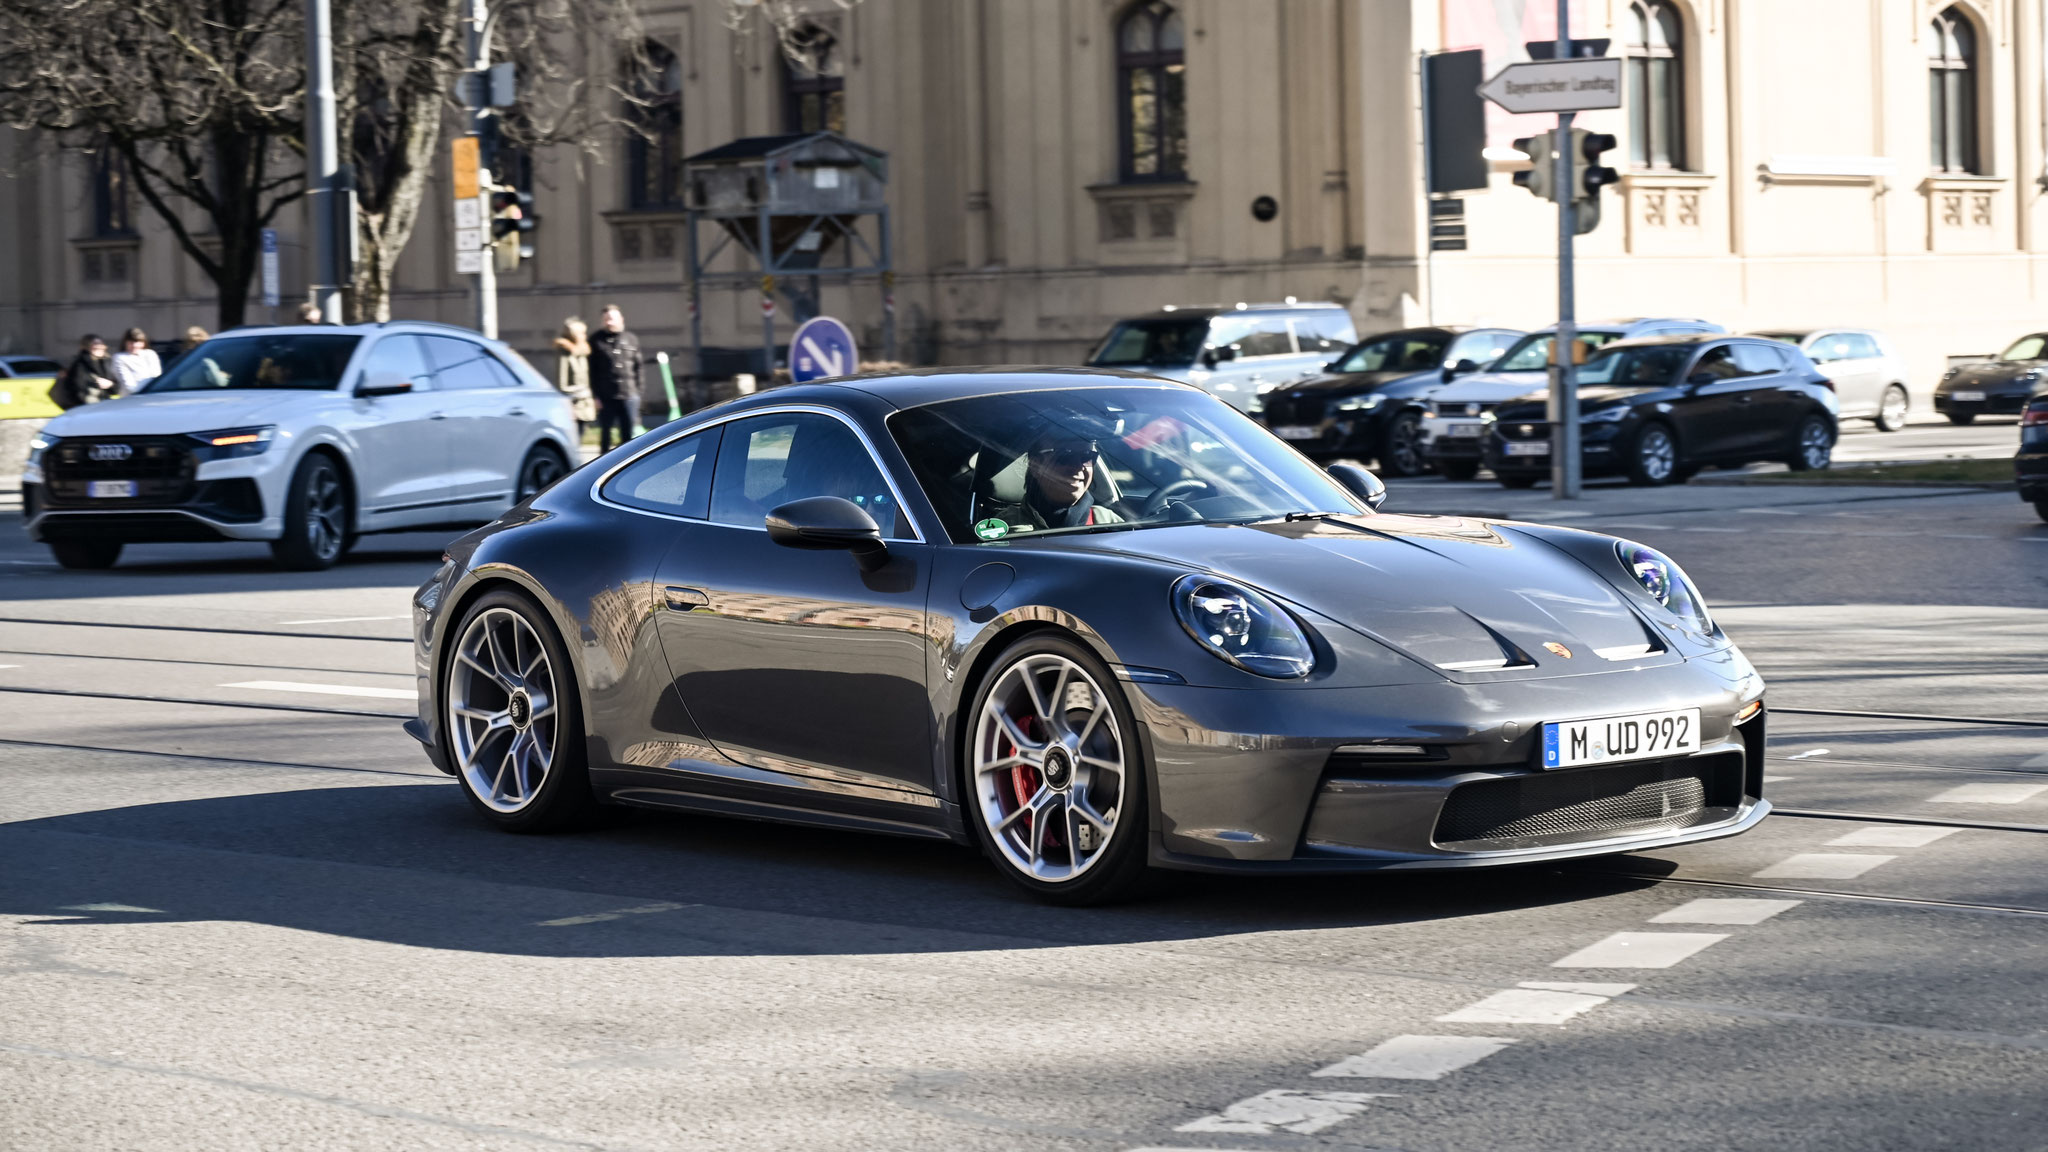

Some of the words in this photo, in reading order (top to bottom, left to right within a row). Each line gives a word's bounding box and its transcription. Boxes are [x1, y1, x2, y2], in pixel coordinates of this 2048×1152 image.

[1505, 78, 1569, 97] Bayerischer
[1571, 75, 1616, 93] Landtag
[986, 519, 996, 529] 4
[1571, 726, 1587, 760] M
[1607, 721, 1639, 755] UD
[1646, 715, 1689, 751] 992
[1548, 750, 1557, 761] D
